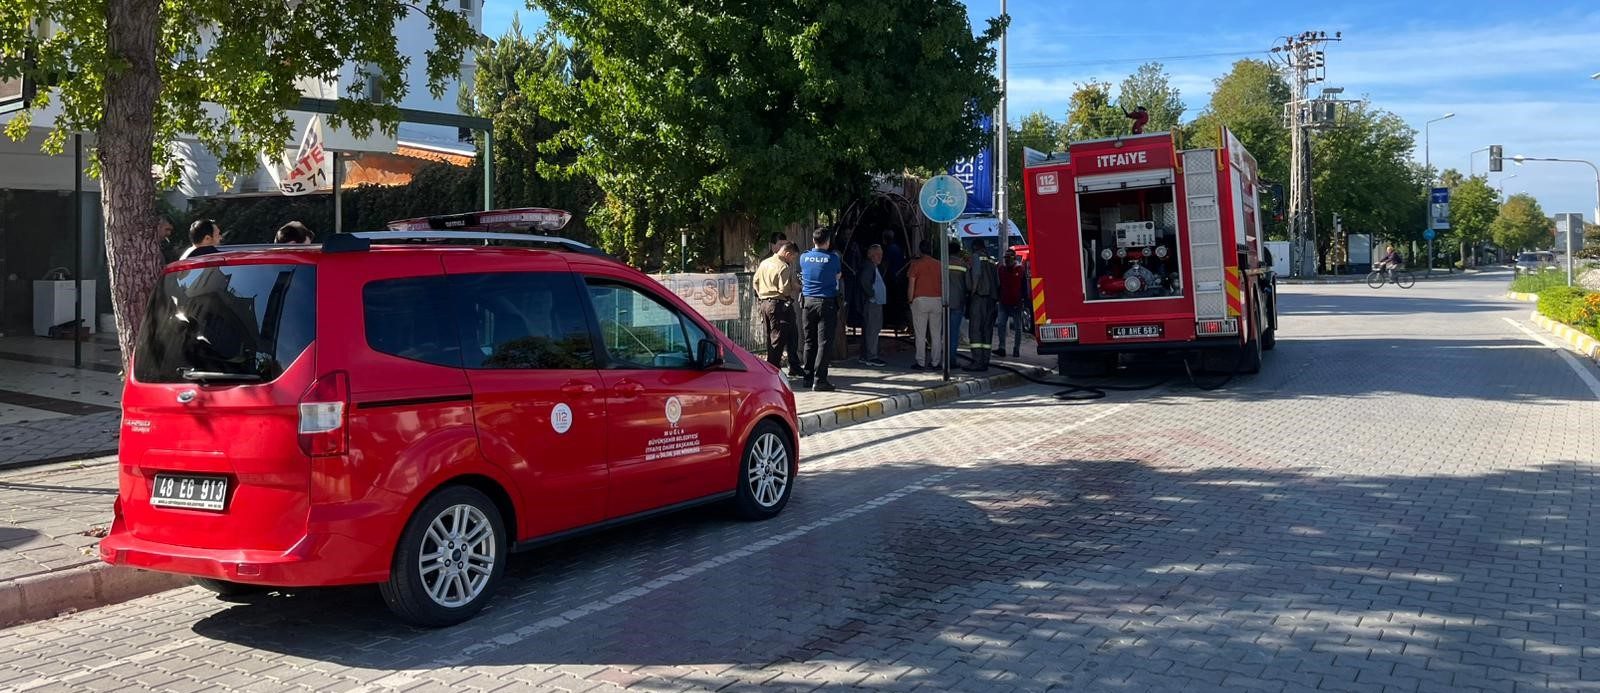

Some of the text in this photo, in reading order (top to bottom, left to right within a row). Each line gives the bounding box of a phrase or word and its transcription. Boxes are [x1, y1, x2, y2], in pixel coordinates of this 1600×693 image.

[1039, 174, 1055, 186] 112
[555, 412, 568, 422] 112
[160, 478, 224, 500] 48 EG 913
